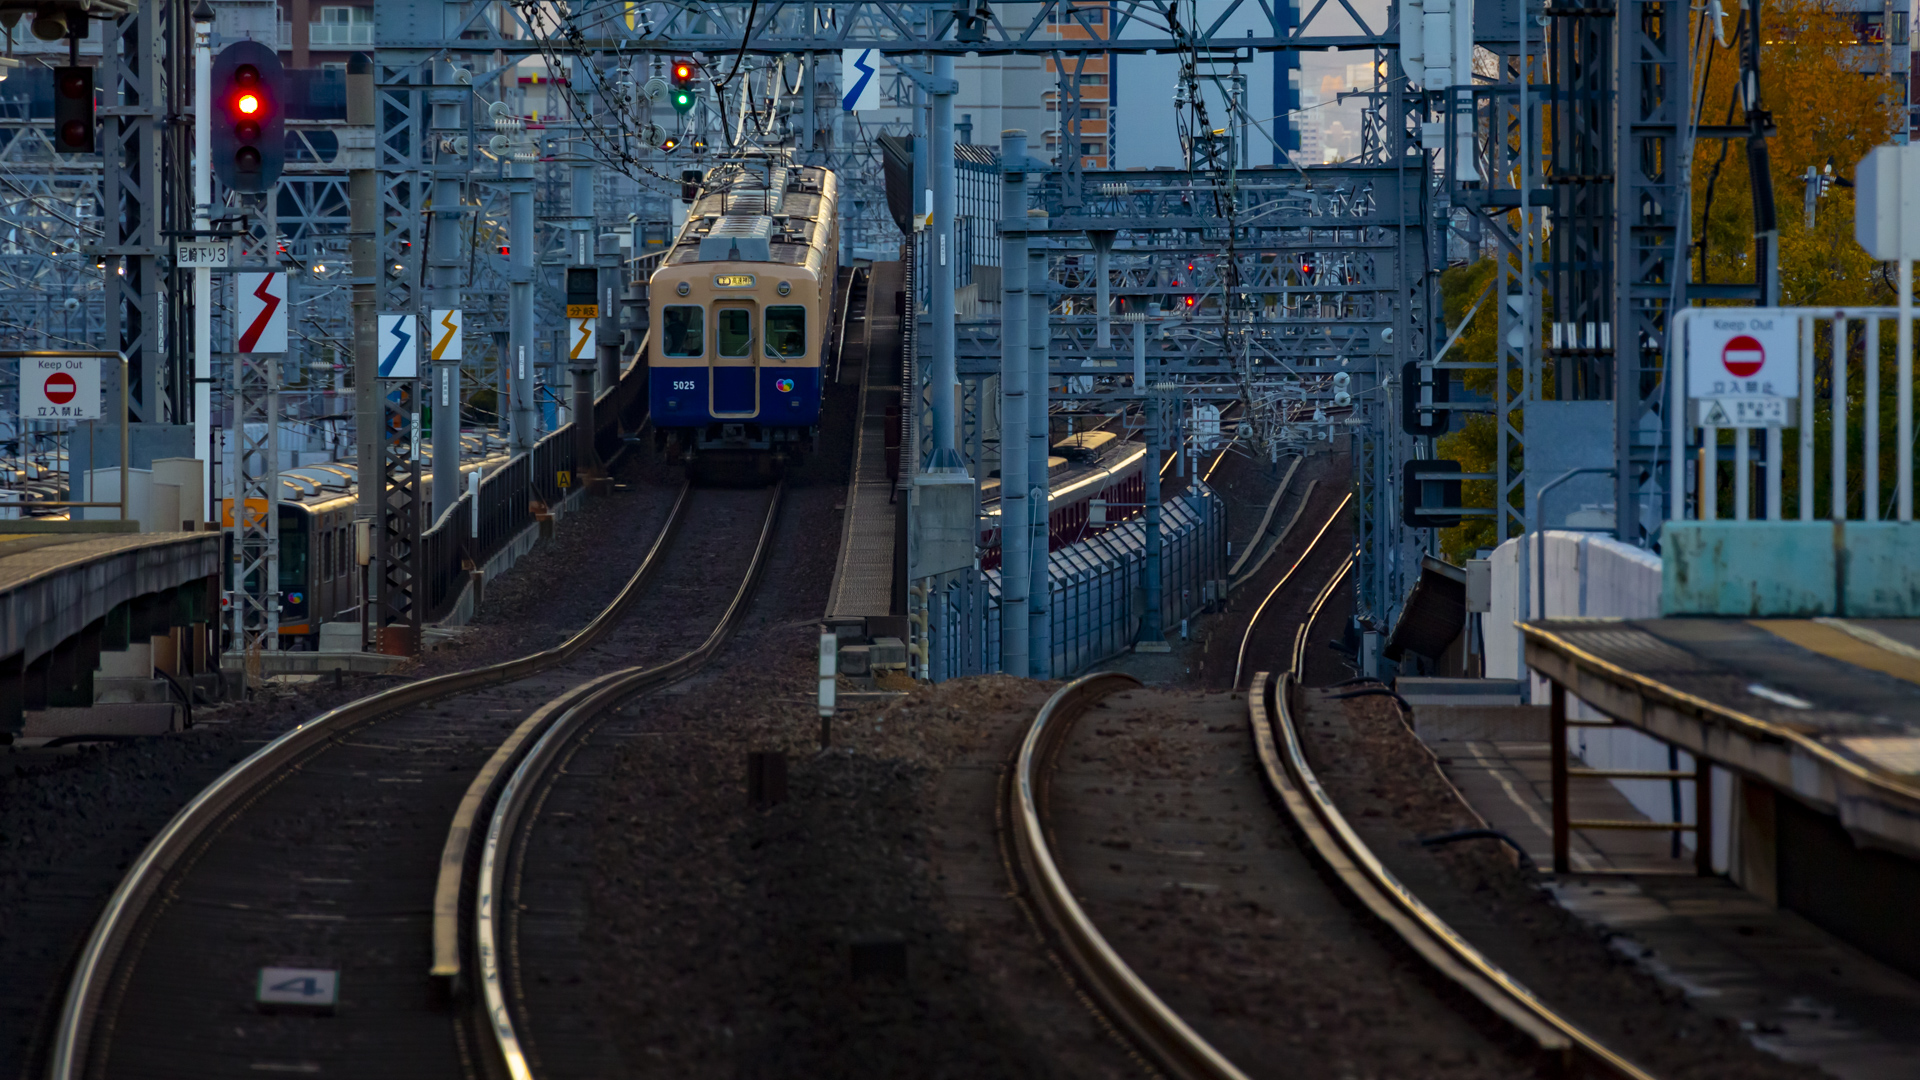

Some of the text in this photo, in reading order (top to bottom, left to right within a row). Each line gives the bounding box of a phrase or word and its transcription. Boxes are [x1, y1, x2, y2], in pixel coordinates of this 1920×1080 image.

[179, 247, 226, 262] 尼崎下り3
[569, 306, 595, 316] 分岐
[1714, 319, 1774, 331] Keep Out
[38, 360, 83, 370] Keep Out
[673, 381, 695, 390] 5025
[1713, 381, 1773, 394] 立入禁止
[37, 406, 83, 416] 立入禁止
[559, 472, 569, 486] A
[270, 977, 324, 995] 4
